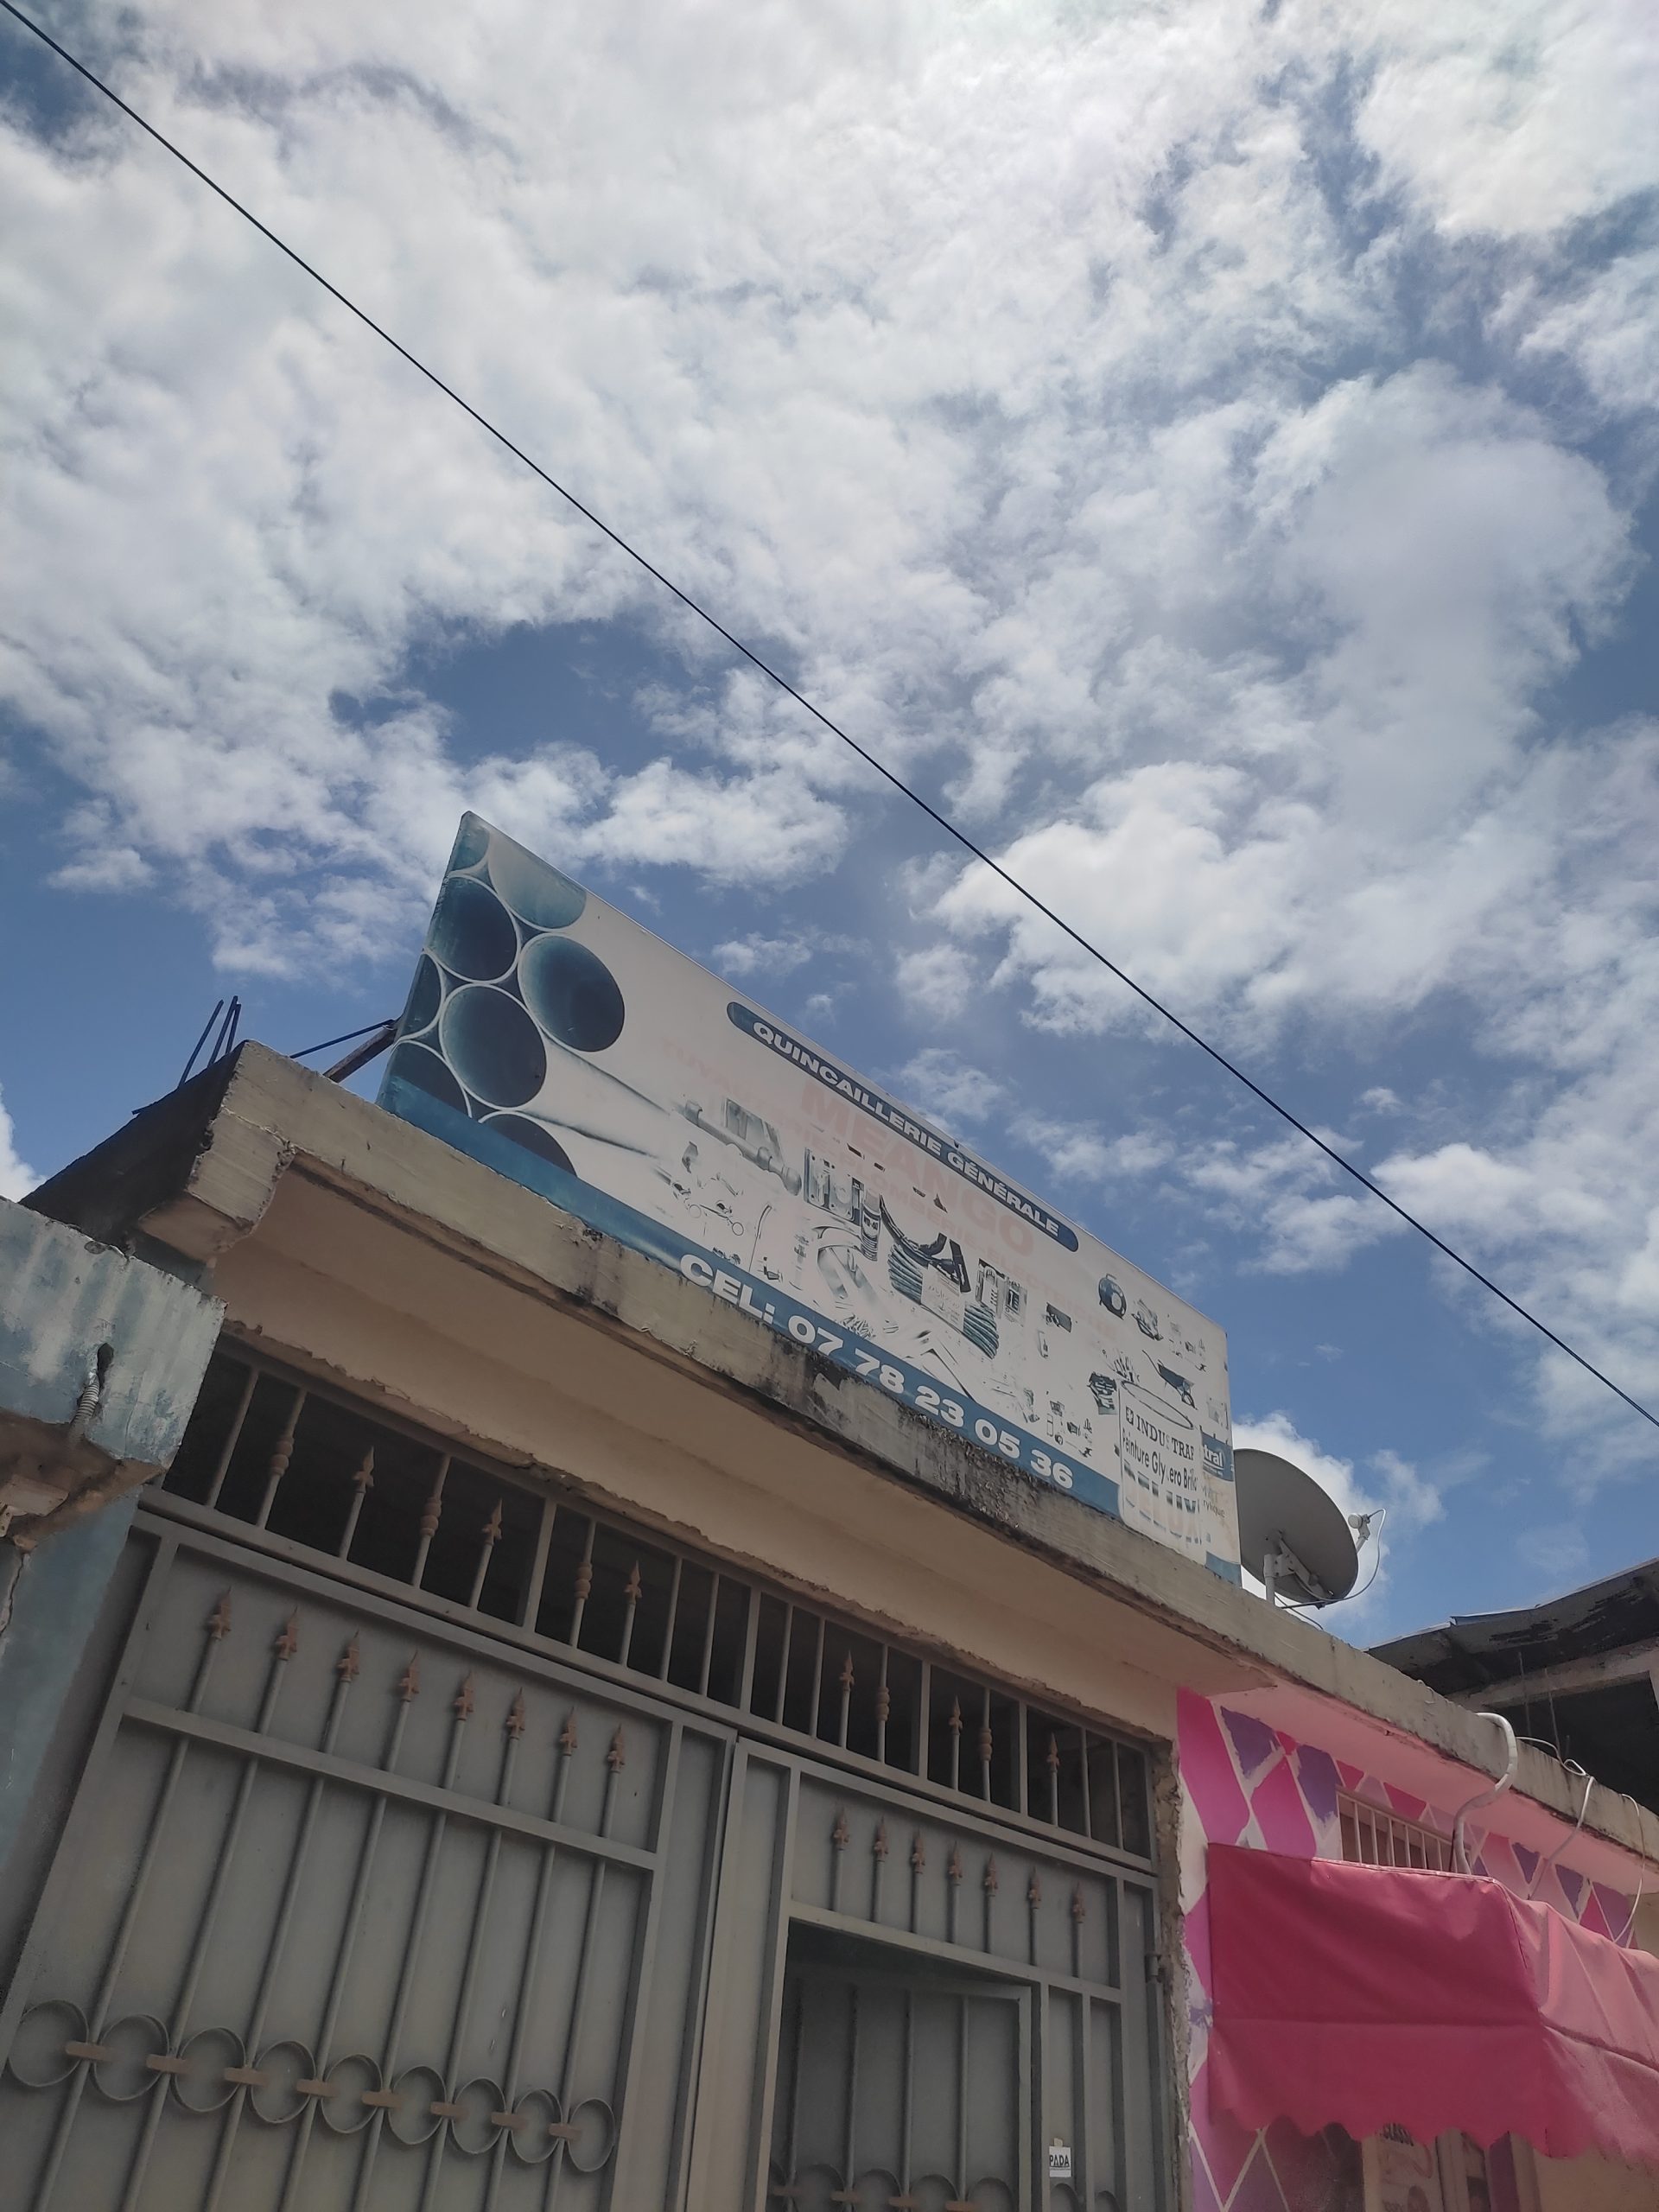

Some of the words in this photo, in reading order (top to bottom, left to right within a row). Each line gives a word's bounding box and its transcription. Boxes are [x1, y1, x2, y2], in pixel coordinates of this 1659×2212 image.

[753, 1021, 943, 1156] QUINCAILLERIE
[947, 1150, 1060, 1237] GÉNÉRALE
[801, 1082, 1034, 1255] MEANGO
[680, 1253, 776, 1325] CEL:
[788, 1315, 844, 1357] 07
[855, 1351, 906, 1394] 78
[914, 1385, 965, 1427] 23
[975, 1418, 1020, 1459] 05
[1030, 1449, 1073, 1489] 36
[1152, 1452, 1182, 1486] Glyero
